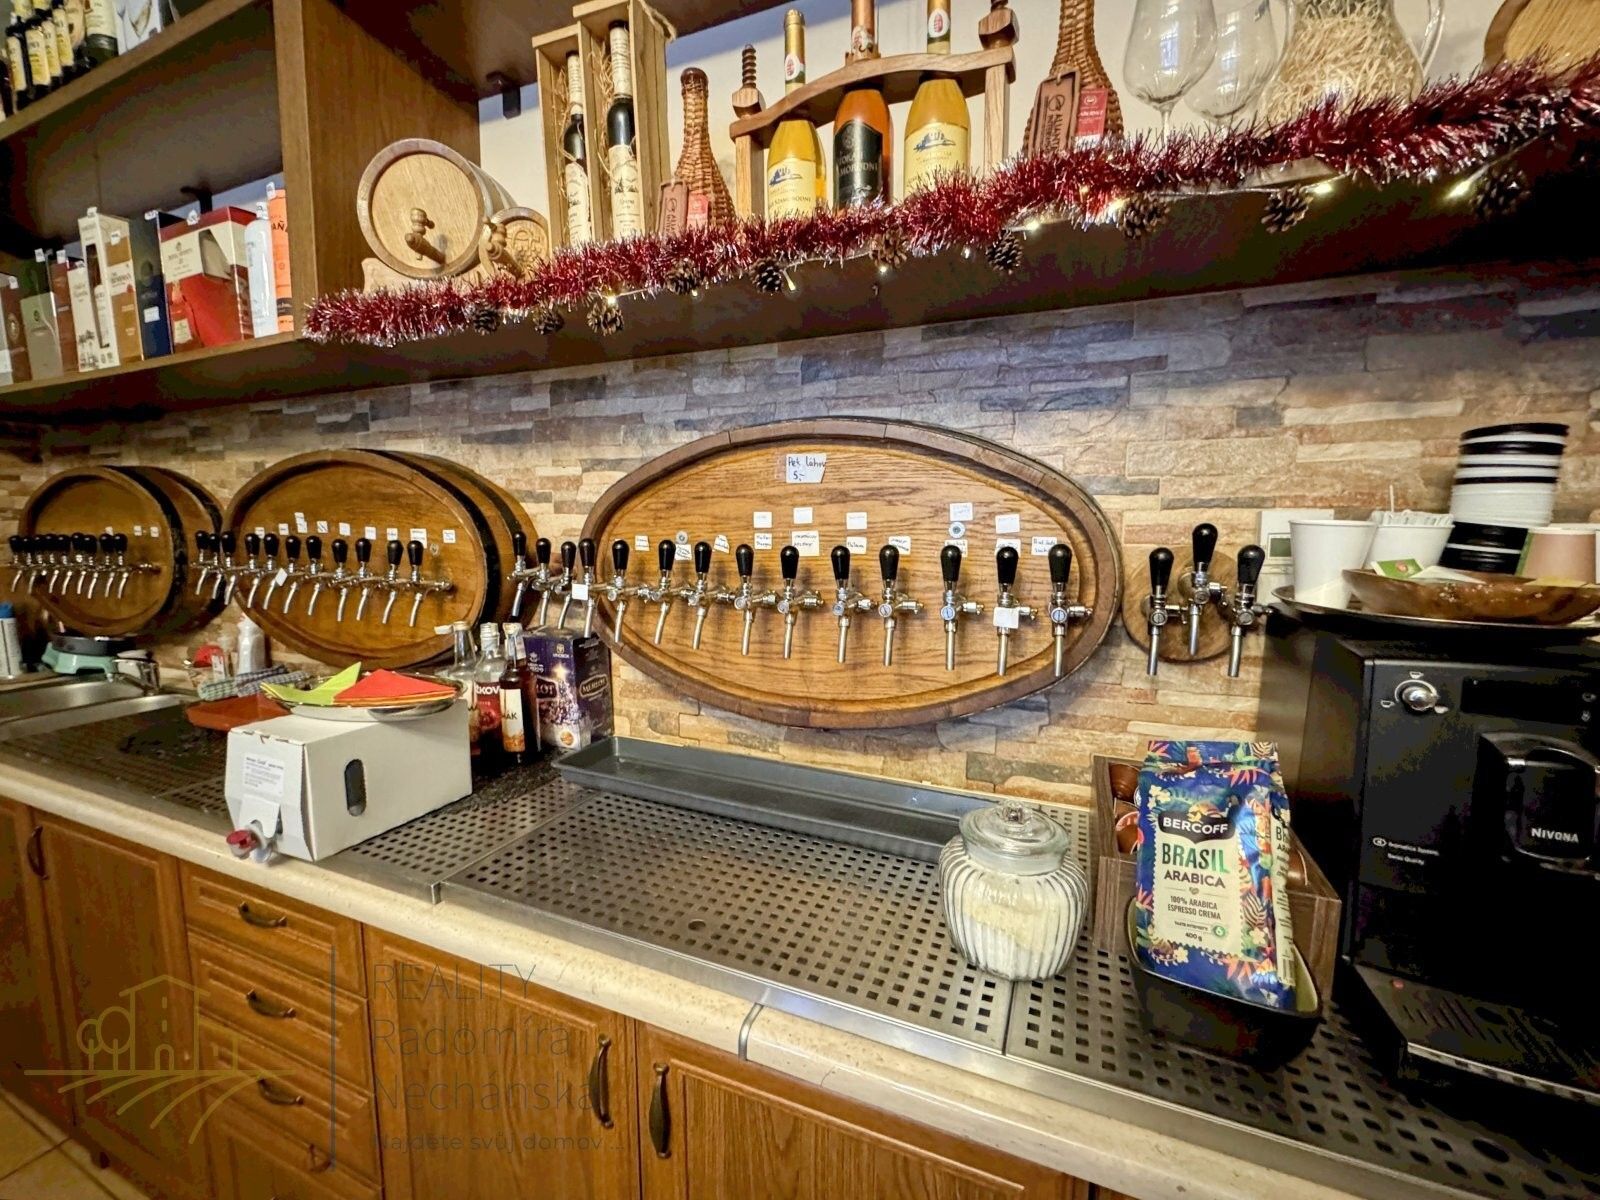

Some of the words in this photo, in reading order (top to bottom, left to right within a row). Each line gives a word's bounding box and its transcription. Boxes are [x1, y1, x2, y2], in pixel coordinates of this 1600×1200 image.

[1162, 817, 1229, 834] BERCOFF
[1162, 842, 1230, 873] BRASIL
[1164, 870, 1226, 889] ARABICA
[1170, 896, 1187, 905] 100%
[1189, 899, 1218, 910] ARABICA
[1167, 904, 1197, 916] ESPRESSO
[1198, 909, 1221, 920] CREMA
